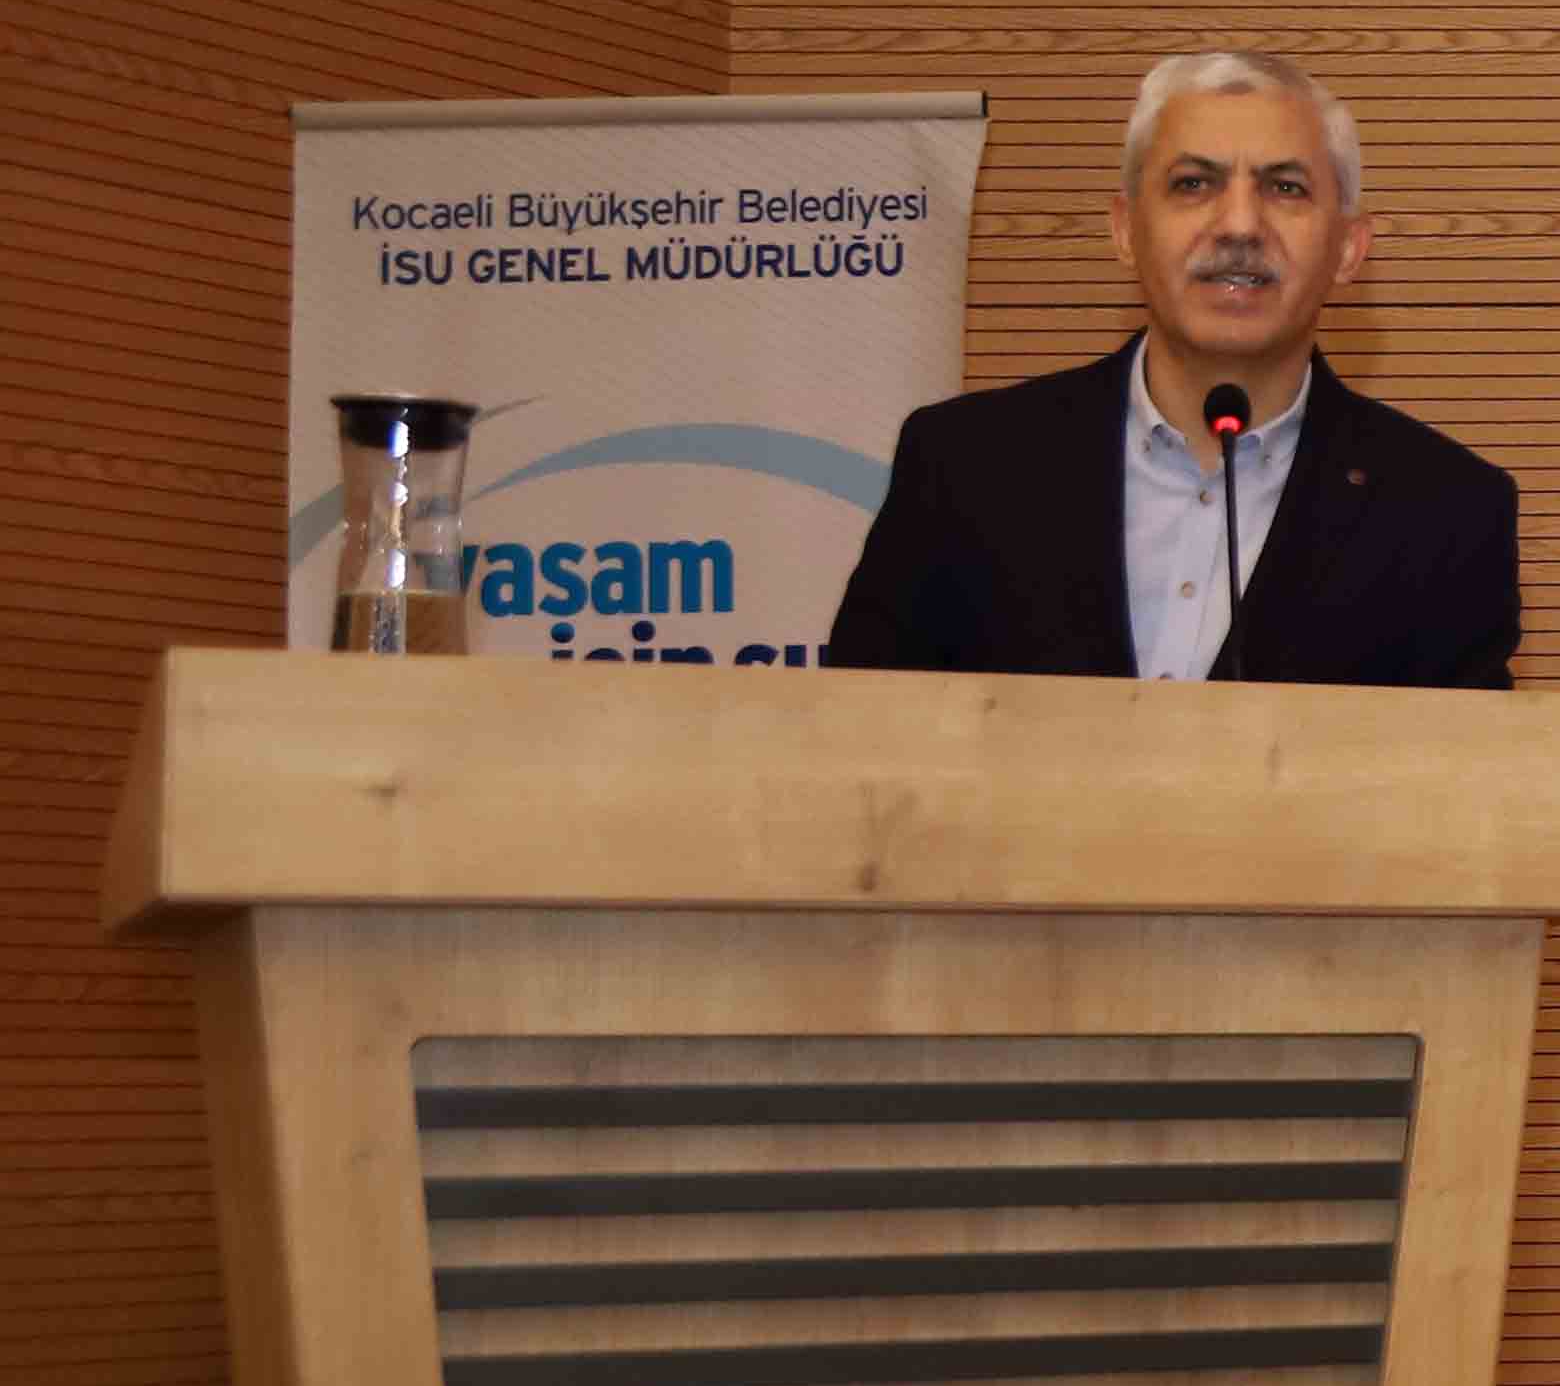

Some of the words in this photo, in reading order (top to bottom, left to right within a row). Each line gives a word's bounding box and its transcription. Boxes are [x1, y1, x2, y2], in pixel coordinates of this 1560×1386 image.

[352, 193, 494, 231] Kocaeli
[507, 188, 724, 236] Büyükşehir
[737, 186, 928, 231] Belediyesi
[379, 238, 454, 286] İSU
[467, 246, 611, 285] GENEL
[625, 233, 905, 282] MÜDÜRLÜĞÜ
